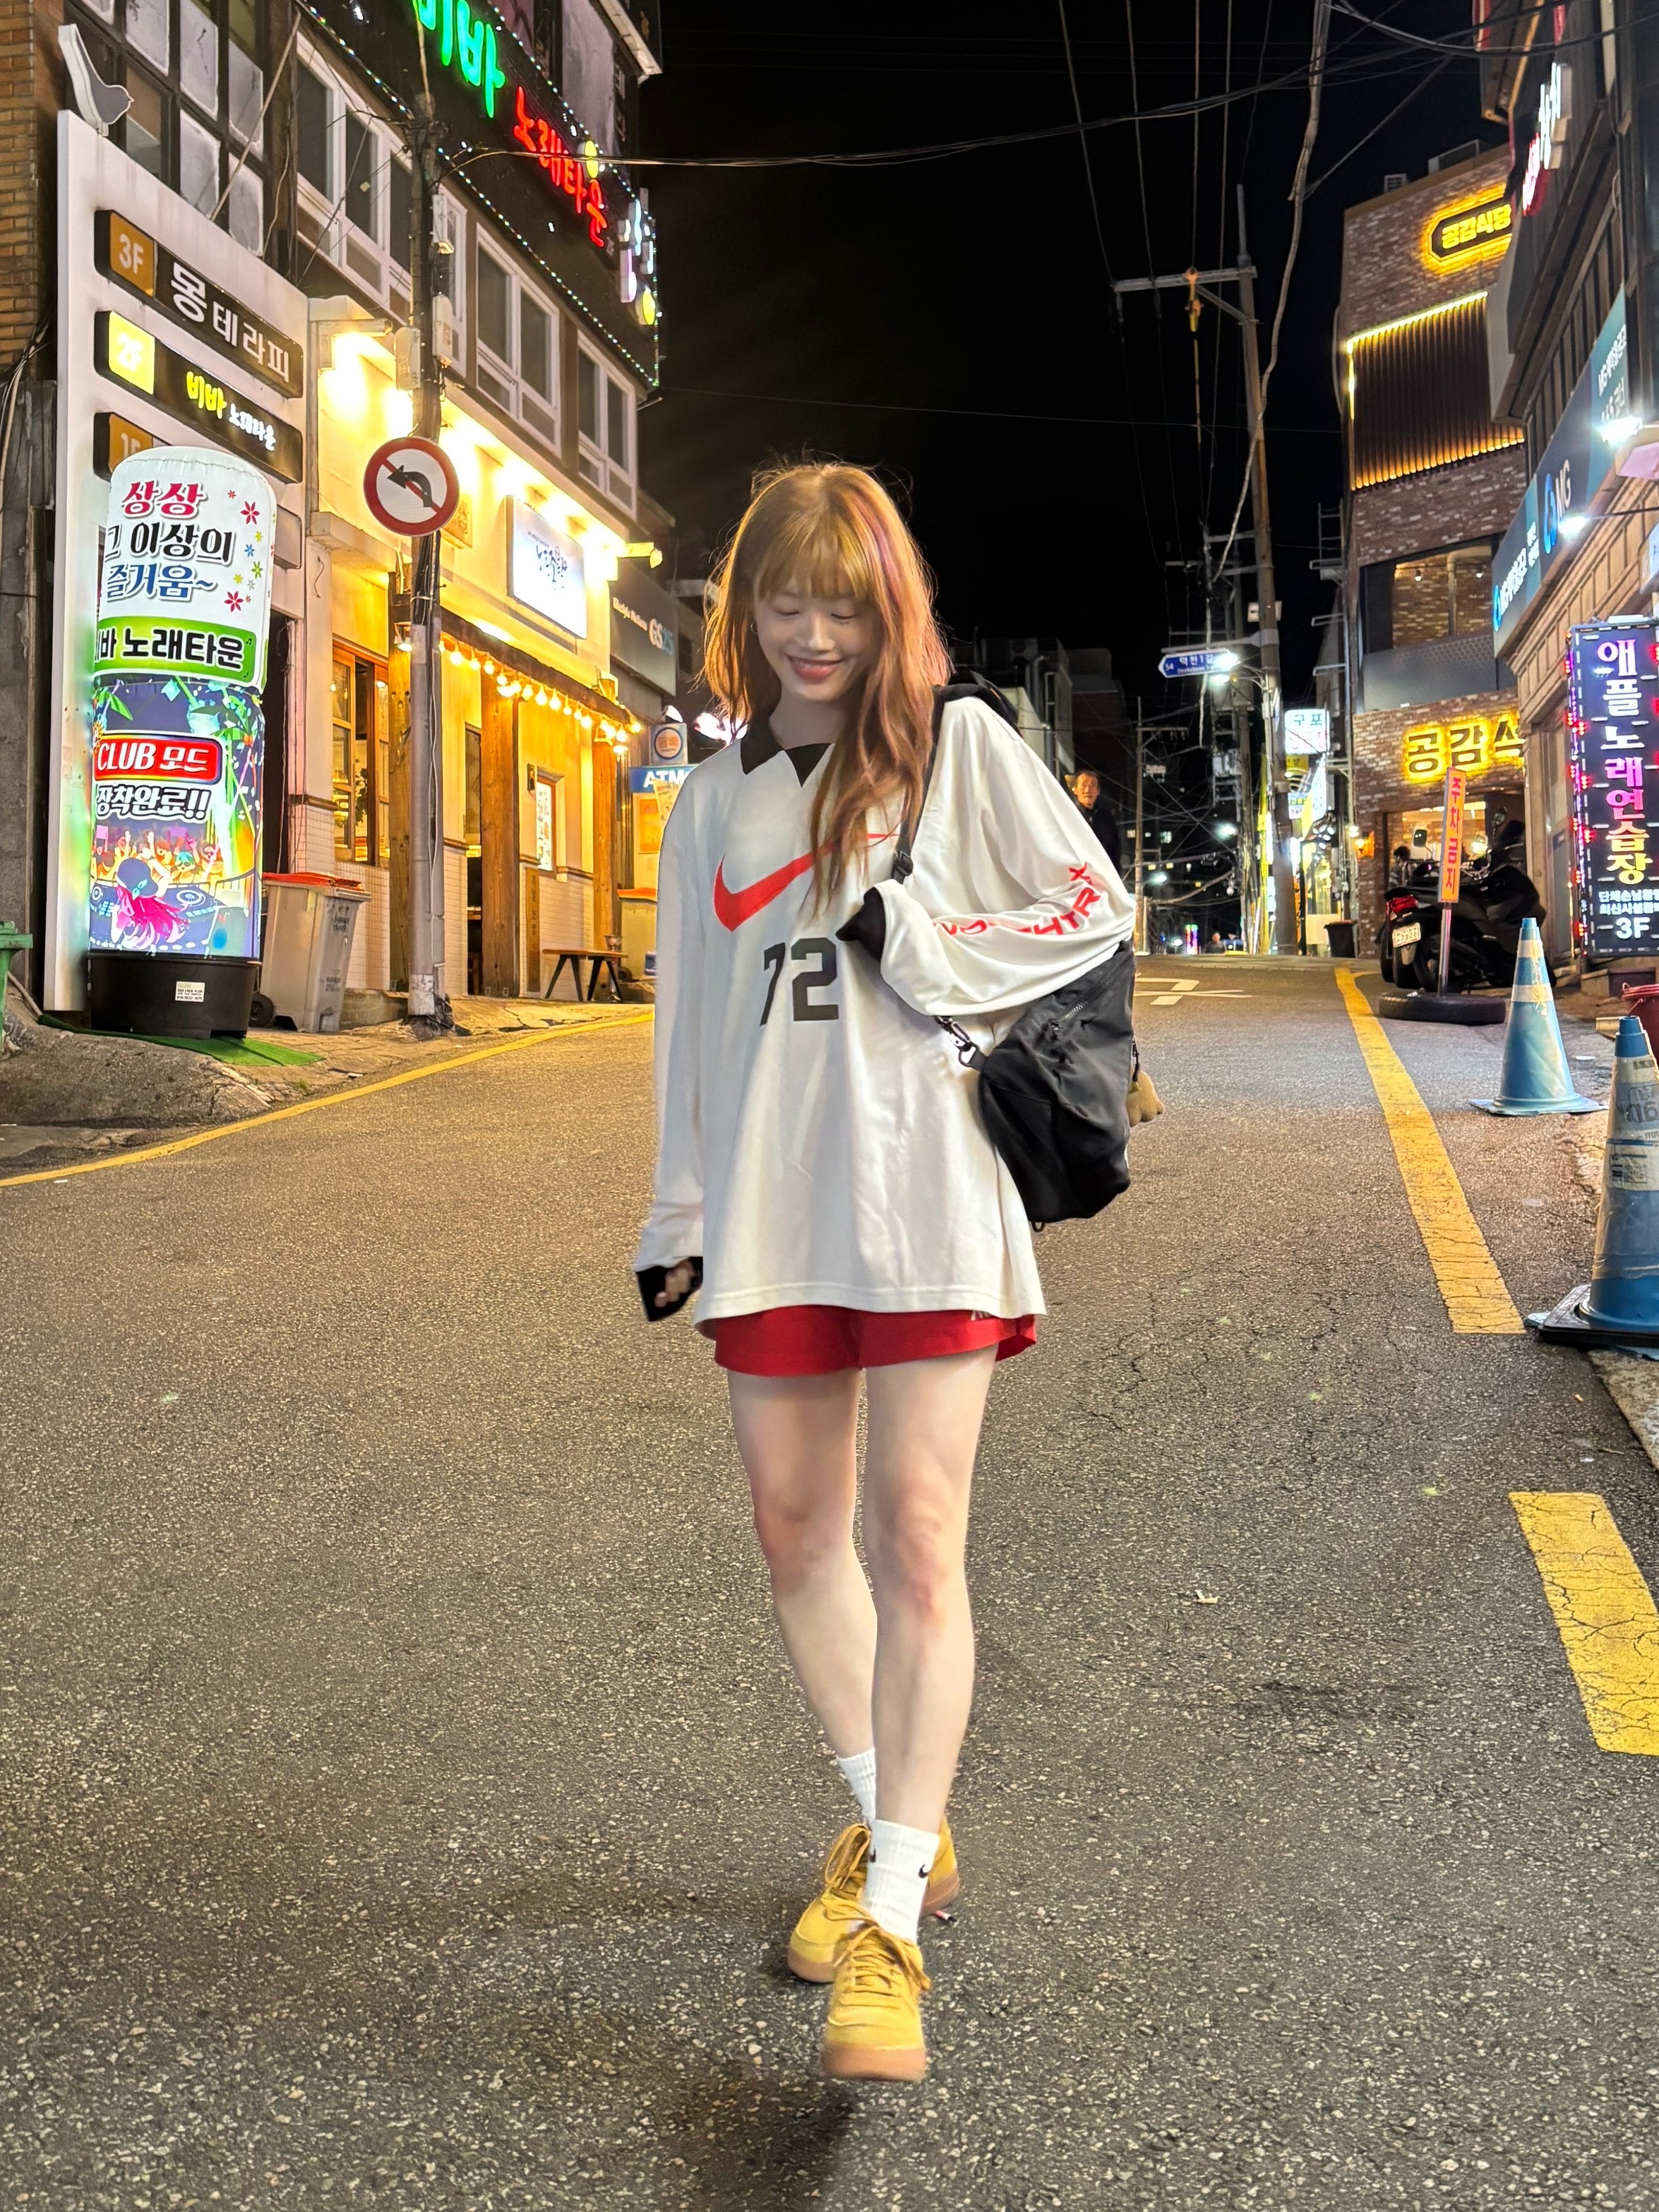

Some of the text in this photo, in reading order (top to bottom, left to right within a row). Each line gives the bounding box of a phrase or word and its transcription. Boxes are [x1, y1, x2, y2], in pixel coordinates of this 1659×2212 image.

[514, 85, 608, 248] 노래타운
[1442, 203, 1512, 250] 공감식당
[119, 233, 144, 275] 3F
[171, 261, 290, 383] 몽테라피
[117, 333, 143, 371] 2F
[186, 371, 227, 419] 비바
[121, 480, 204, 516] 상상
[1555, 459, 1571, 520] MG
[130, 522, 233, 562] 이상의
[107, 563, 214, 599] 즐거움~
[122, 627, 245, 669] 노래타운
[649, 618, 673, 657] GS25
[1293, 713, 1323, 727] 구포
[97, 742, 210, 773] CLUB 모드
[96, 784, 211, 819] 장착완료!!
[1445, 777, 1462, 895] 주차금지
[1615, 916, 1651, 940] 3F
[760, 937, 839, 1027] 72
